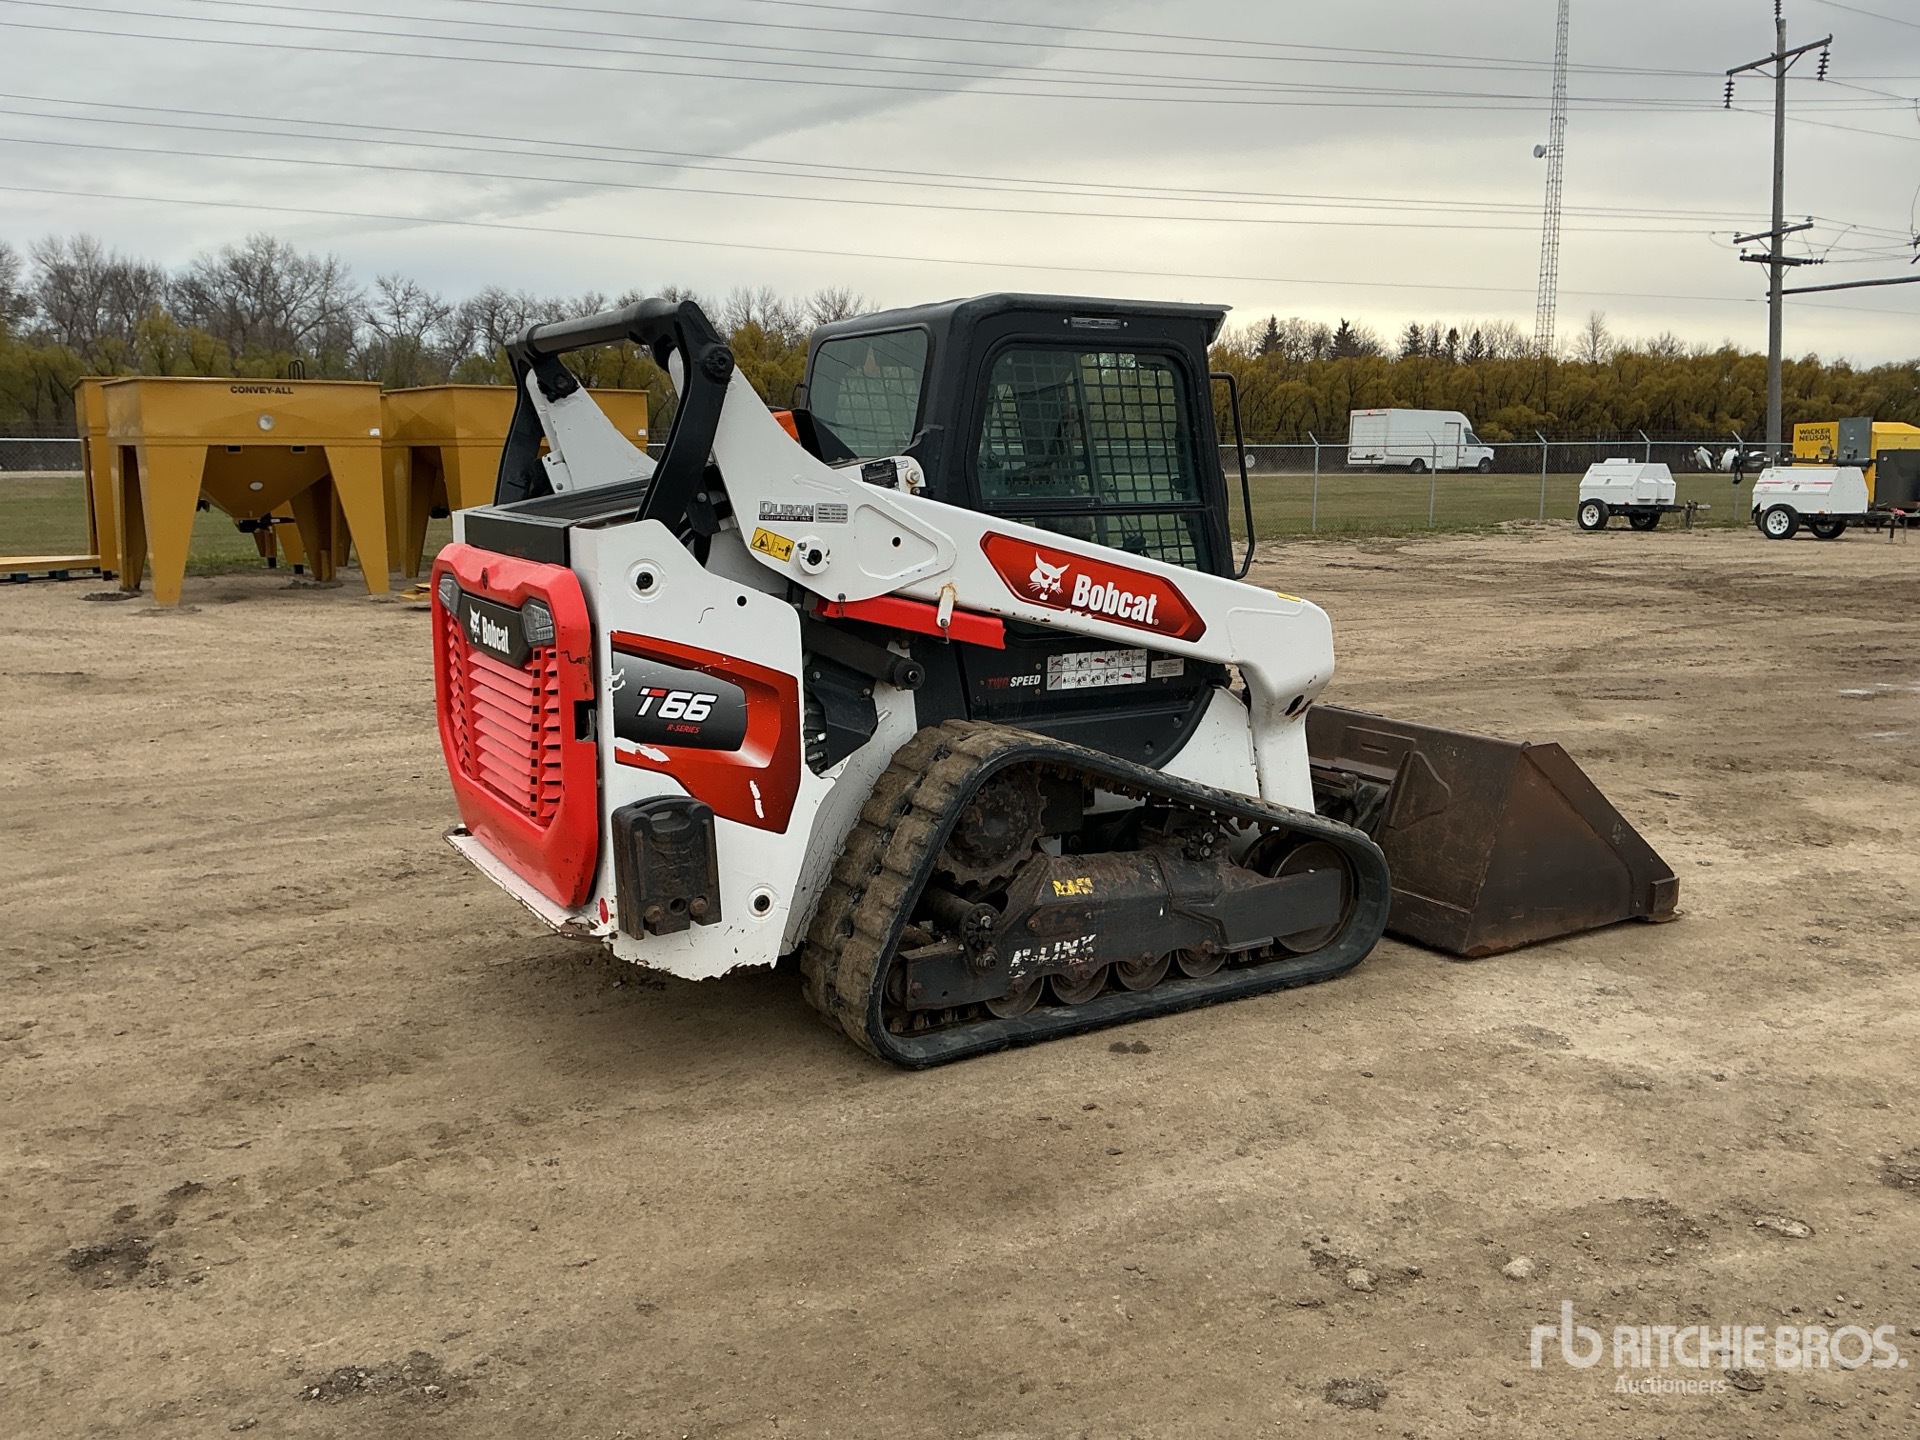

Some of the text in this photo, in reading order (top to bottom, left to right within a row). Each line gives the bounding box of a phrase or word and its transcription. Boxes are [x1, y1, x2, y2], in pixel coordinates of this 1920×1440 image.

[230, 385, 294, 395] CONVEY-ALL
[1798, 434, 1831, 442] NEUSON
[759, 500, 815, 516] DURON
[1071, 573, 1159, 625] Bobcat
[481, 615, 510, 655] Bobcat
[988, 674, 1041, 688] TWO SPEED
[636, 686, 719, 722] T66
[666, 723, 701, 734] R-SERIES
